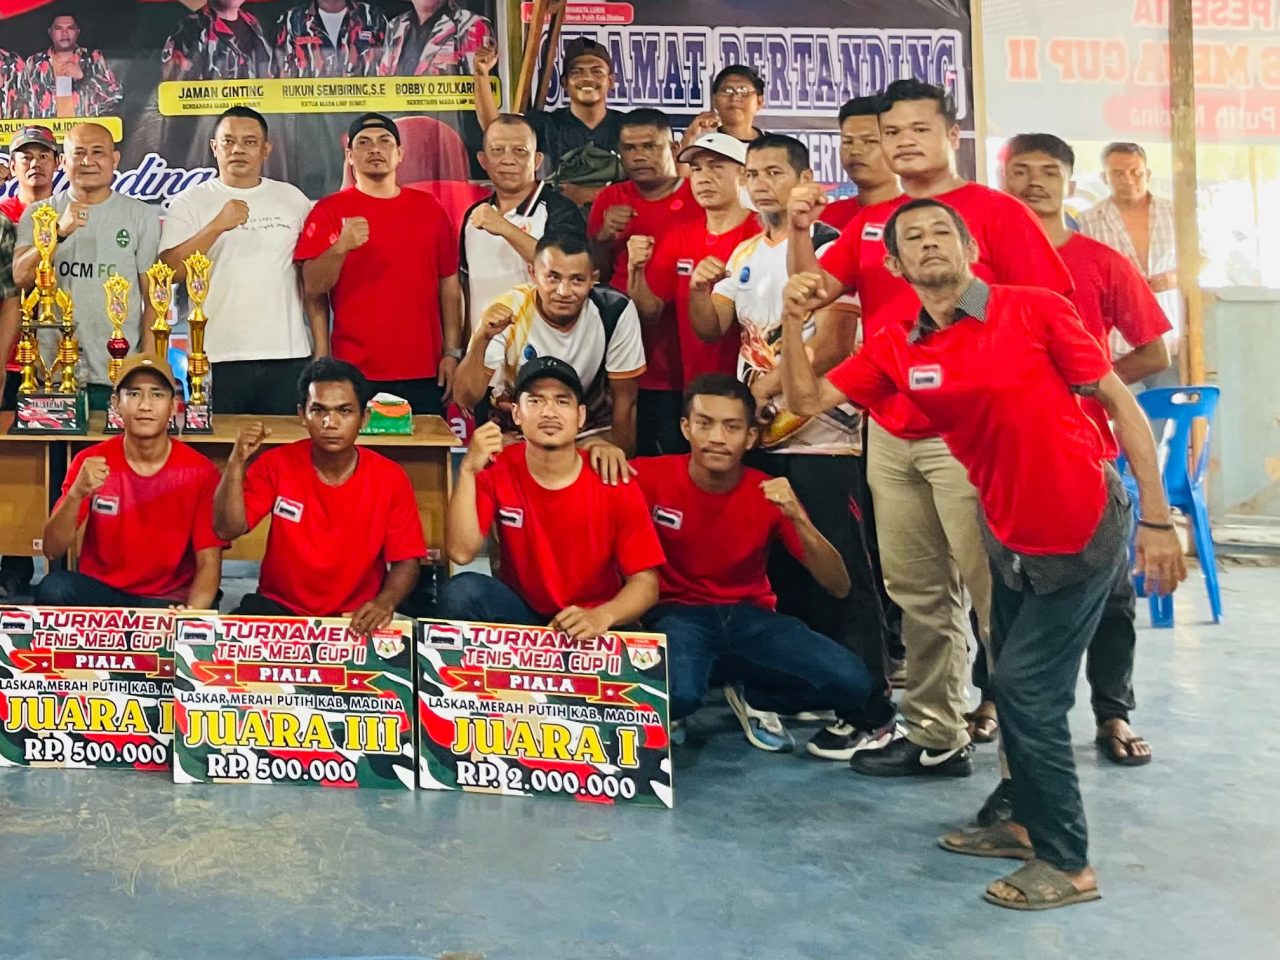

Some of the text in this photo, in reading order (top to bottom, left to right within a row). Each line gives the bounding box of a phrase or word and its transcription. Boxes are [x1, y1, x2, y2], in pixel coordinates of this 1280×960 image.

[179, 86, 264, 99] JAMAN GINTING
[283, 85, 314, 97] RUKUN
[396, 83, 425, 94] BOBBY
[59, 261, 93, 278] OCM
[39, 611, 173, 631] TURNAMEN
[35, 632, 162, 650] TENIS MEJA CUP
[222, 622, 361, 643] TURNAMEN
[470, 627, 616, 652] TURNAMEN
[76, 655, 135, 669] PIALA
[217, 642, 367, 664] TENIS MEJA CUP II
[465, 648, 621, 674] TENIS MEJA CUP II
[259, 667, 322, 683] PIALA
[509, 675, 575, 693] PIALA
[0, 679, 159, 694] LASKAR MERAH PUTIH KAB.
[180, 693, 403, 711] LASKAR MERAH PUTIH KAB. MADINA
[428, 697, 660, 725] LASKAR MERAH PUTIH KAB. MADINA
[6, 696, 149, 734] JUARA
[185, 711, 401, 754] JUARA III
[451, 716, 640, 769] JUARA I
[24, 738, 167, 765] RP. 500.000
[207, 753, 357, 782] RP. 500.000
[457, 760, 636, 800] RP. 2.000.000
